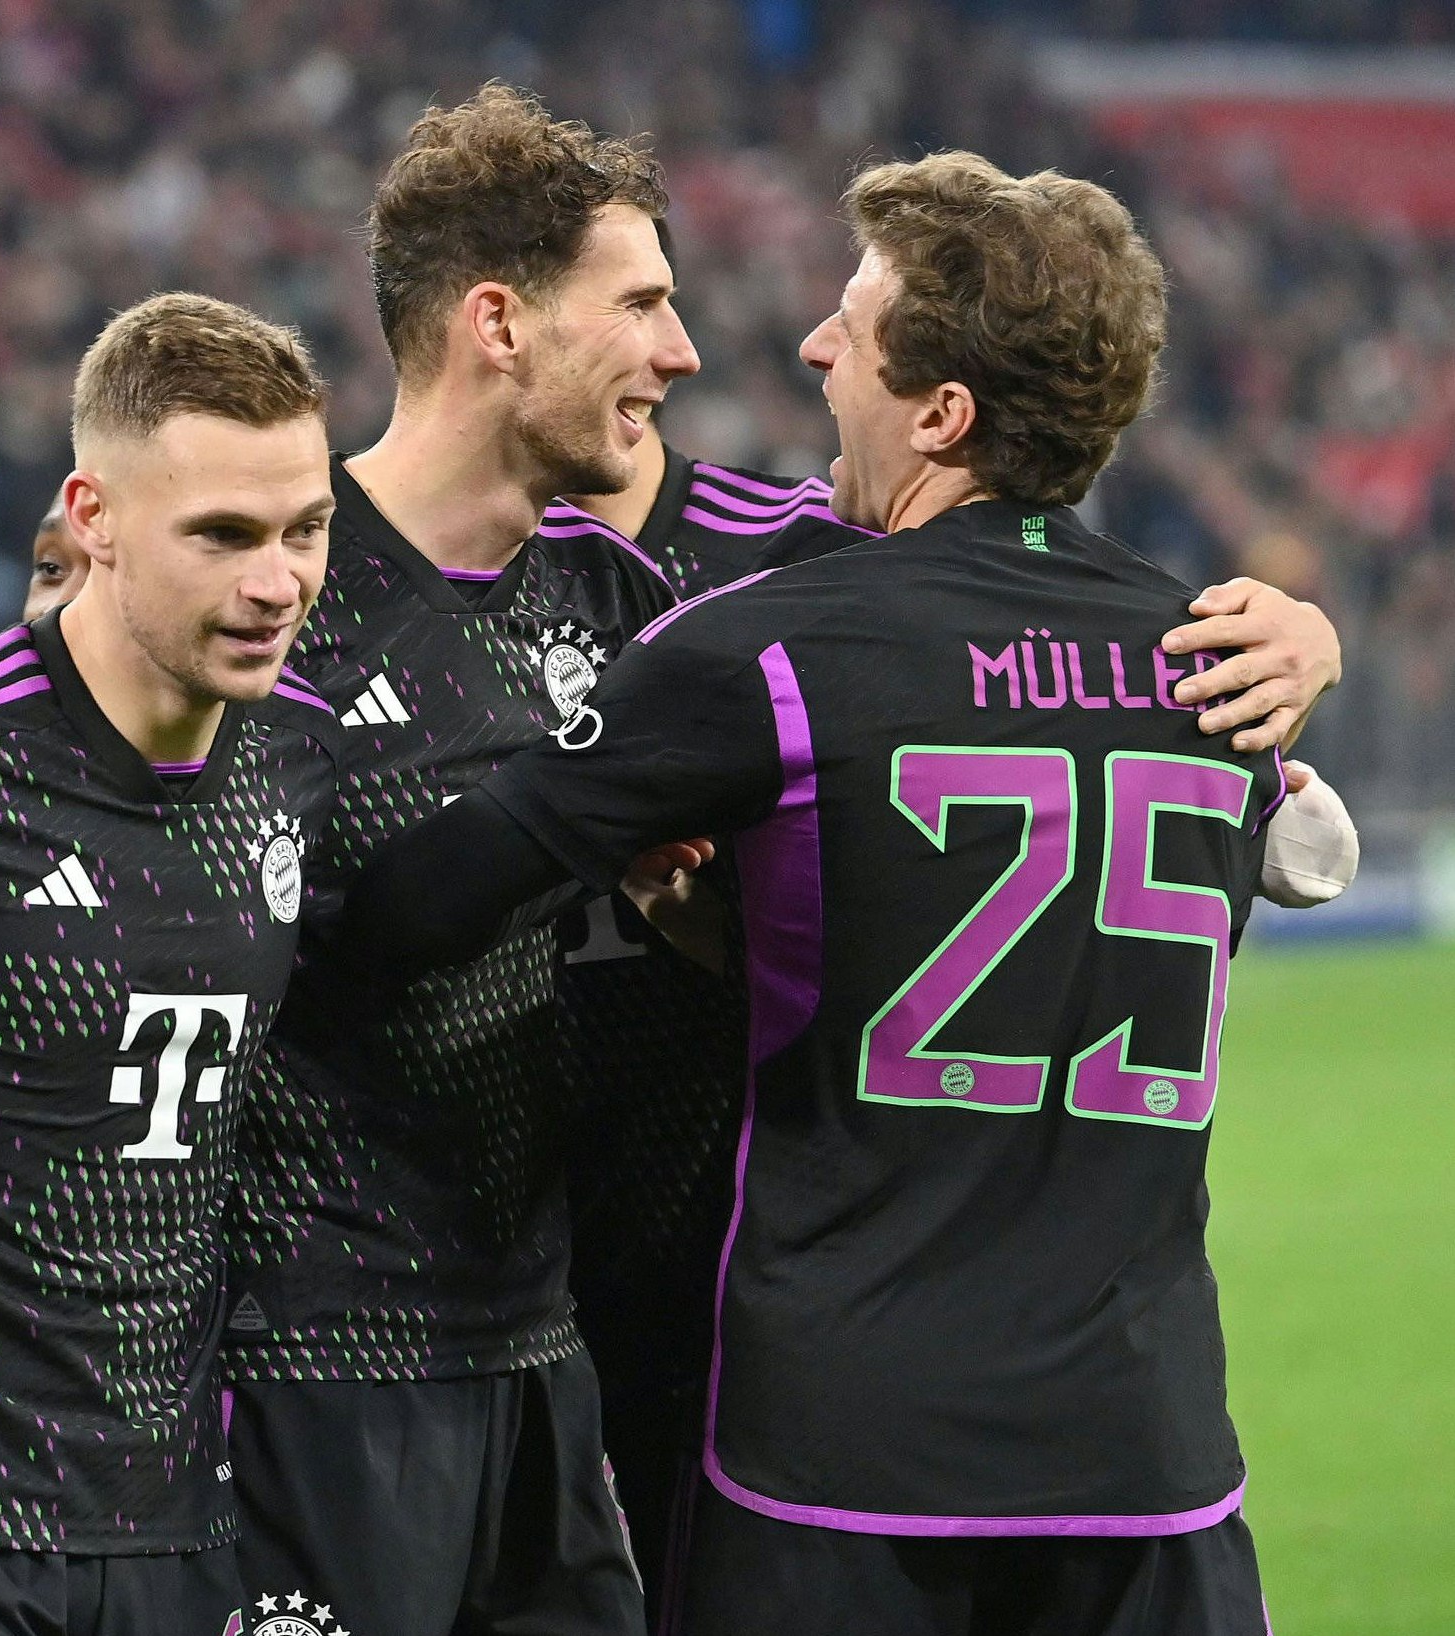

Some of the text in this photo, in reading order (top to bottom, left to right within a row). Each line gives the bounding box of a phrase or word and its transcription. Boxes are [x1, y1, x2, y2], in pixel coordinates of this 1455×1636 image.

[1021, 531, 1046, 545] SAN
[1022, 516, 1045, 530] MIA
[858, 744, 1254, 1131] 25
[109, 993, 249, 1160] T
